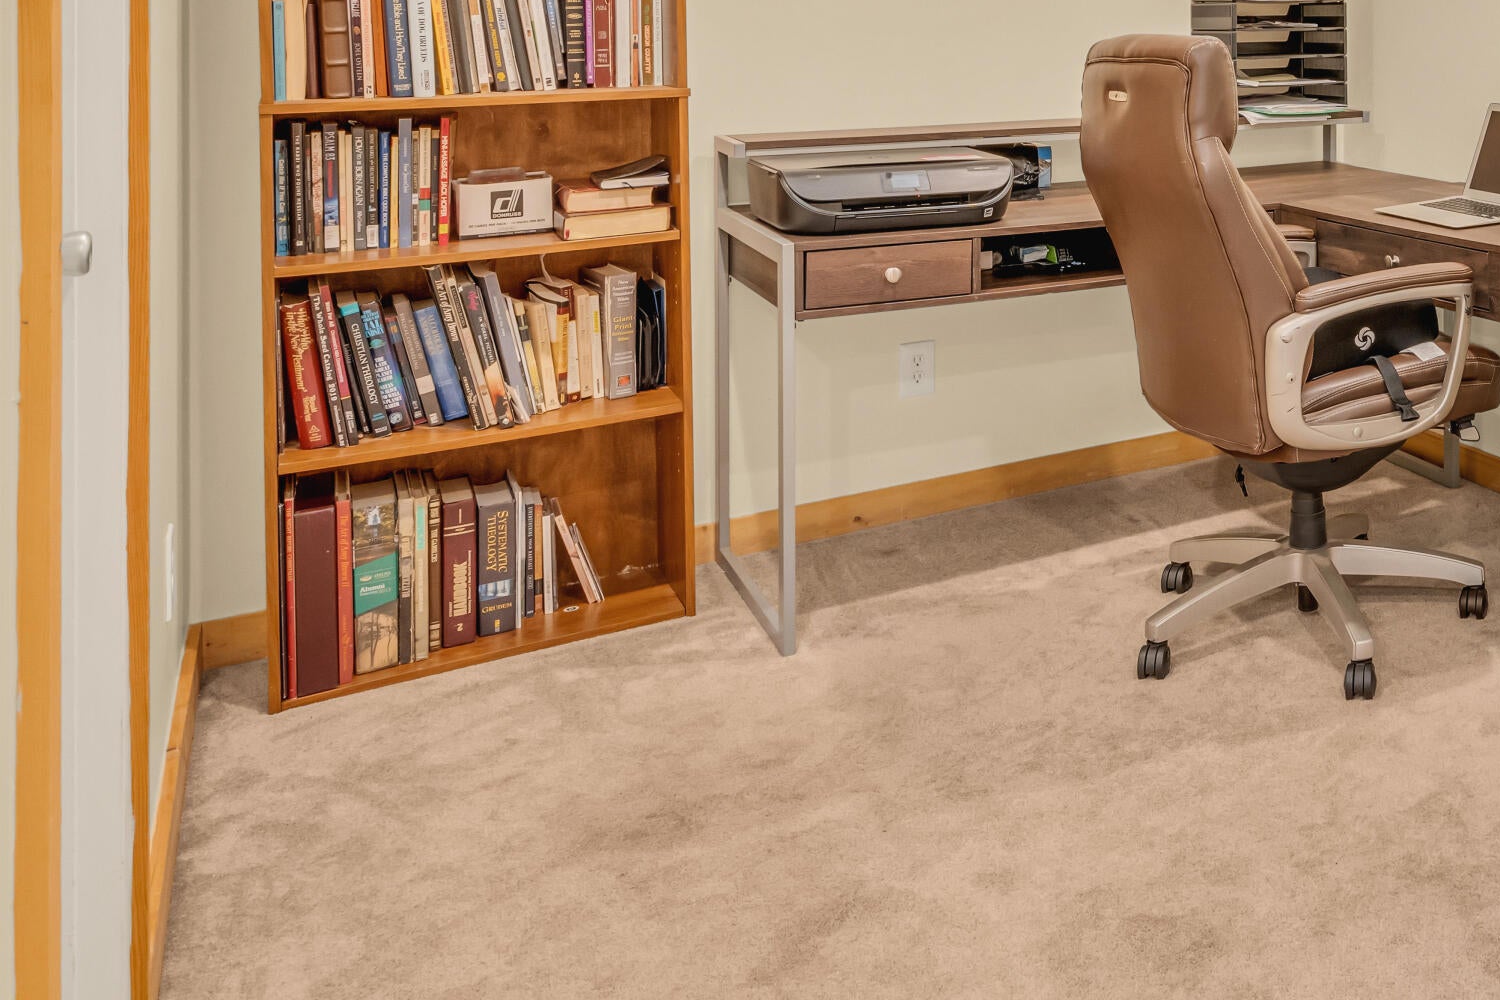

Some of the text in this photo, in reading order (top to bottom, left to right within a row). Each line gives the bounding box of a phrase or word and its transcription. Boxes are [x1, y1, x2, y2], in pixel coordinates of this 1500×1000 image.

[393, 4, 403, 19] Bible
[417, 7, 425, 17] OF
[496, 7, 506, 31] mindset
[394, 19, 404, 32] and
[418, 18, 426, 34] DOG
[396, 32, 405, 46] How
[396, 46, 407, 62] They
[419, 35, 427, 63] BREEDS
[355, 57, 363, 81] OSTEEN
[397, 63, 407, 80] Lived
[324, 131, 336, 161] PSALM 83
[355, 136, 363, 154] HOW
[278, 175, 285, 185] Me
[355, 166, 363, 184] BORN
[440, 135, 449, 217] MINI-MASSAGE JACK HOFER
[355, 184, 364, 206] AGAIN
[492, 211, 522, 219] DONRUSS
[434, 279, 444, 290] The
[437, 291, 447, 301] Art
[442, 307, 454, 322] Amy
[287, 320, 299, 332] the
[447, 323, 459, 342] Brown
[614, 323, 632, 331] Print
[289, 333, 301, 349] New
[300, 331, 312, 350] Who
[313, 296, 338, 401] The Whole Seed Catalog 2019
[351, 323, 378, 405] CHRISTIAN THEOLOGY
[339, 515, 349, 526] The
[340, 527, 349, 538] Art
[486, 510, 510, 573] SYSTEMATIC THEOLOGY
[339, 546, 349, 560] Amy
[341, 561, 349, 580] Brown
[360, 584, 386, 593] Alumni
[453, 561, 468, 617] HANDBOOK
[481, 602, 513, 614] GRUDEM
